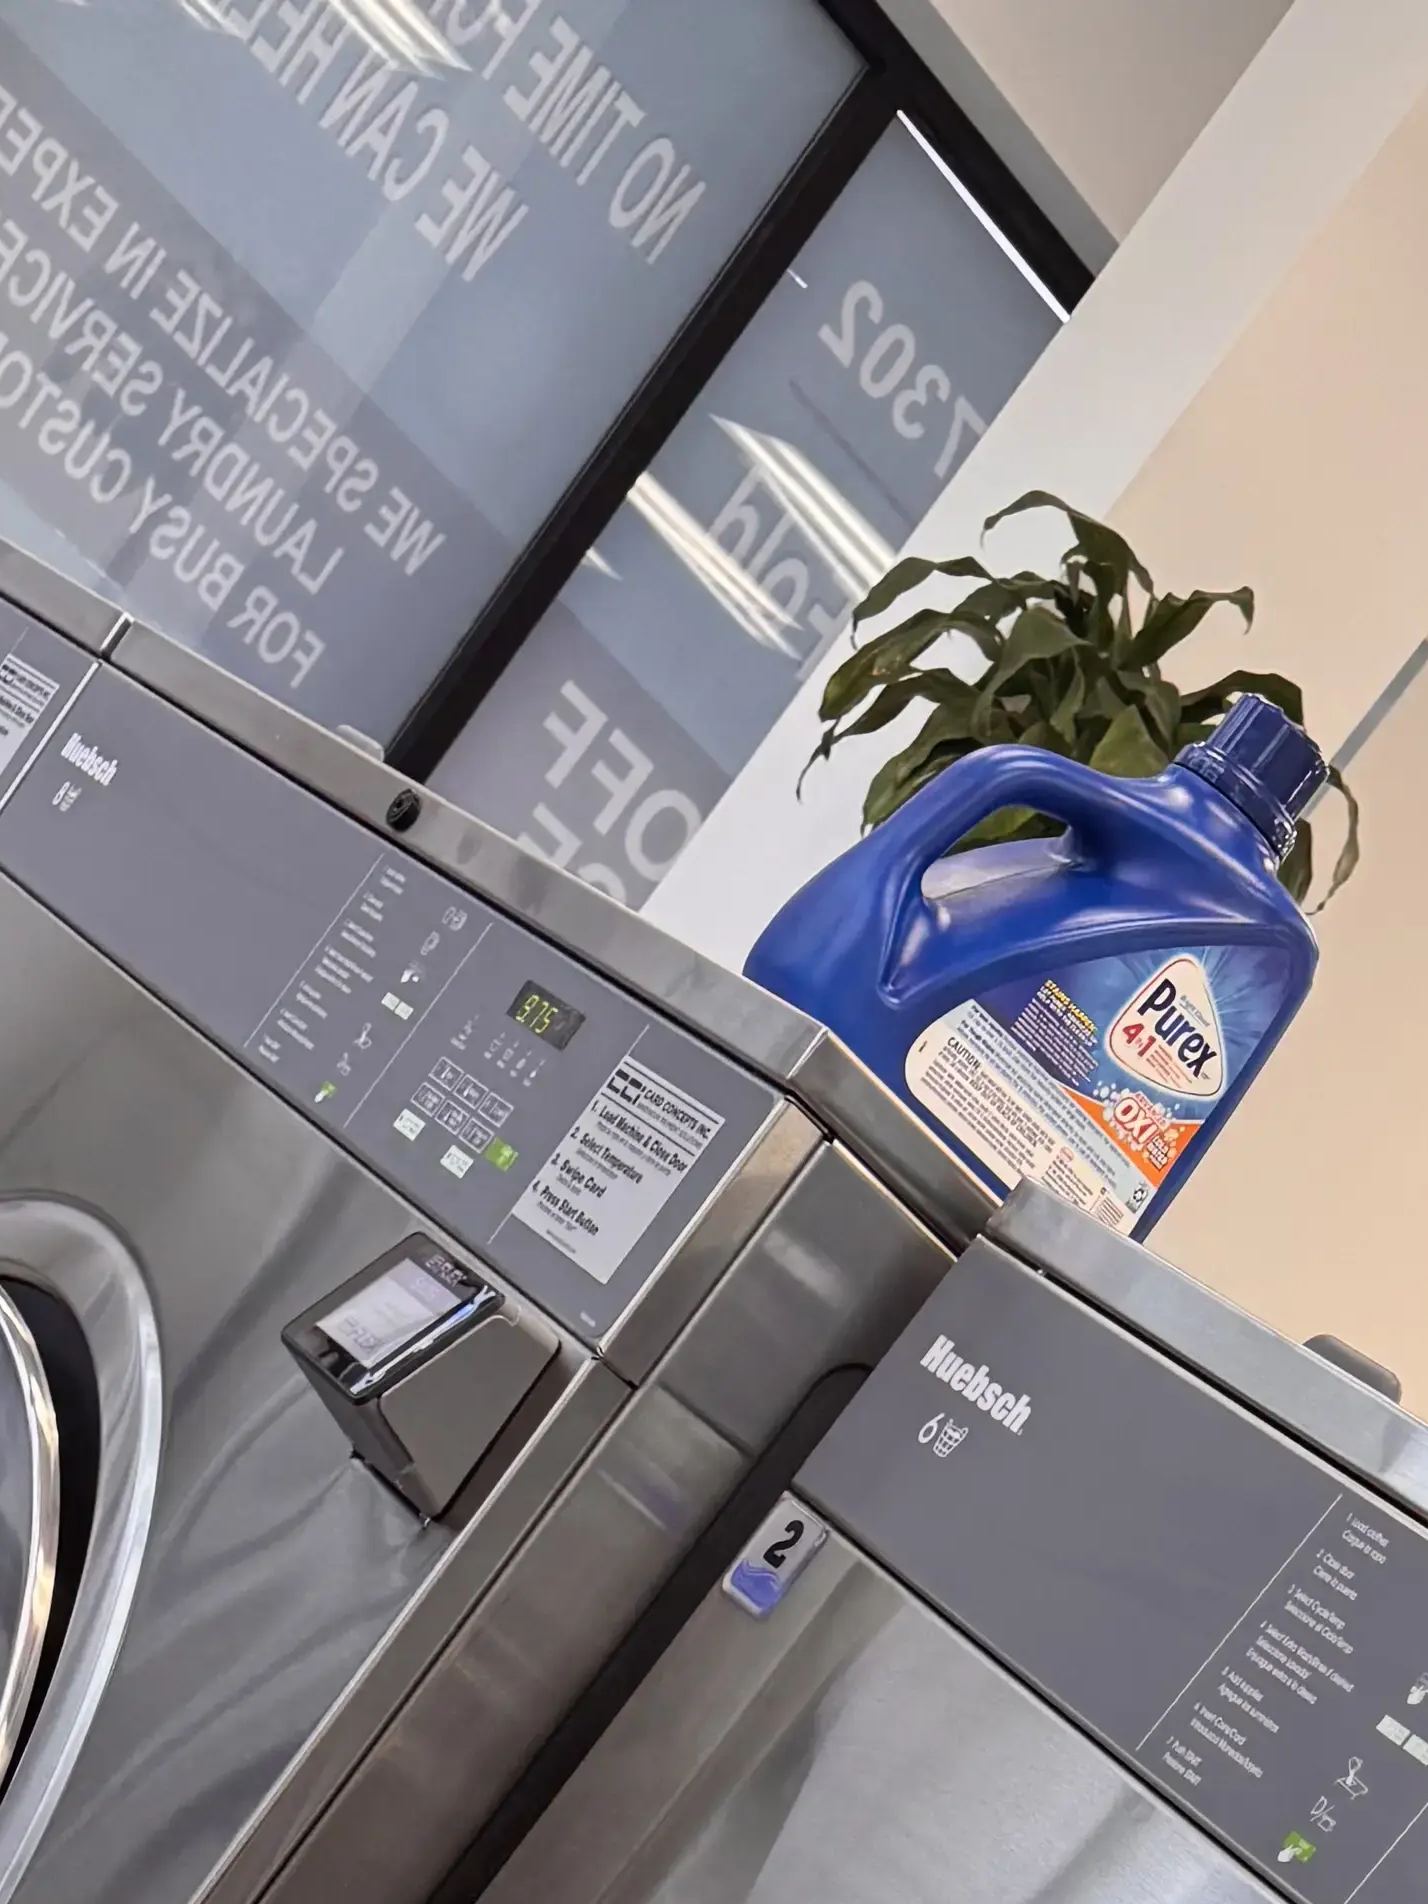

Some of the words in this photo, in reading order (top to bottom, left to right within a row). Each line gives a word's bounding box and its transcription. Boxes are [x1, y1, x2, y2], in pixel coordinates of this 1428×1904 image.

[60, 732, 121, 786] Huebsch
[50, 780, 72, 806] 8
[1121, 1023, 1142, 1045] 4
[1136, 1035, 1155, 1058] 1
[1137, 978, 1216, 1078] Purex
[598, 1105, 620, 1125] Load
[614, 1116, 646, 1143] Machine
[648, 1139, 673, 1161] Close
[668, 1153, 689, 1173] Door
[643, 1088, 665, 1108] CARD
[661, 1100, 698, 1130] CONCEPTS
[695, 1123, 712, 1140] INC.
[1113, 1094, 1156, 1146] OXI
[557, 1159, 587, 1186] Swipe
[582, 1176, 607, 1198] Card
[578, 1132, 604, 1155] Select
[598, 1147, 644, 1186] Temperature
[539, 1185, 562, 1207] Press
[557, 1199, 579, 1220] Start
[573, 1211, 601, 1237] Button
[919, 1333, 1038, 1434] Huebsch
[914, 1409, 947, 1447] 6
[761, 1516, 808, 1570] 2
